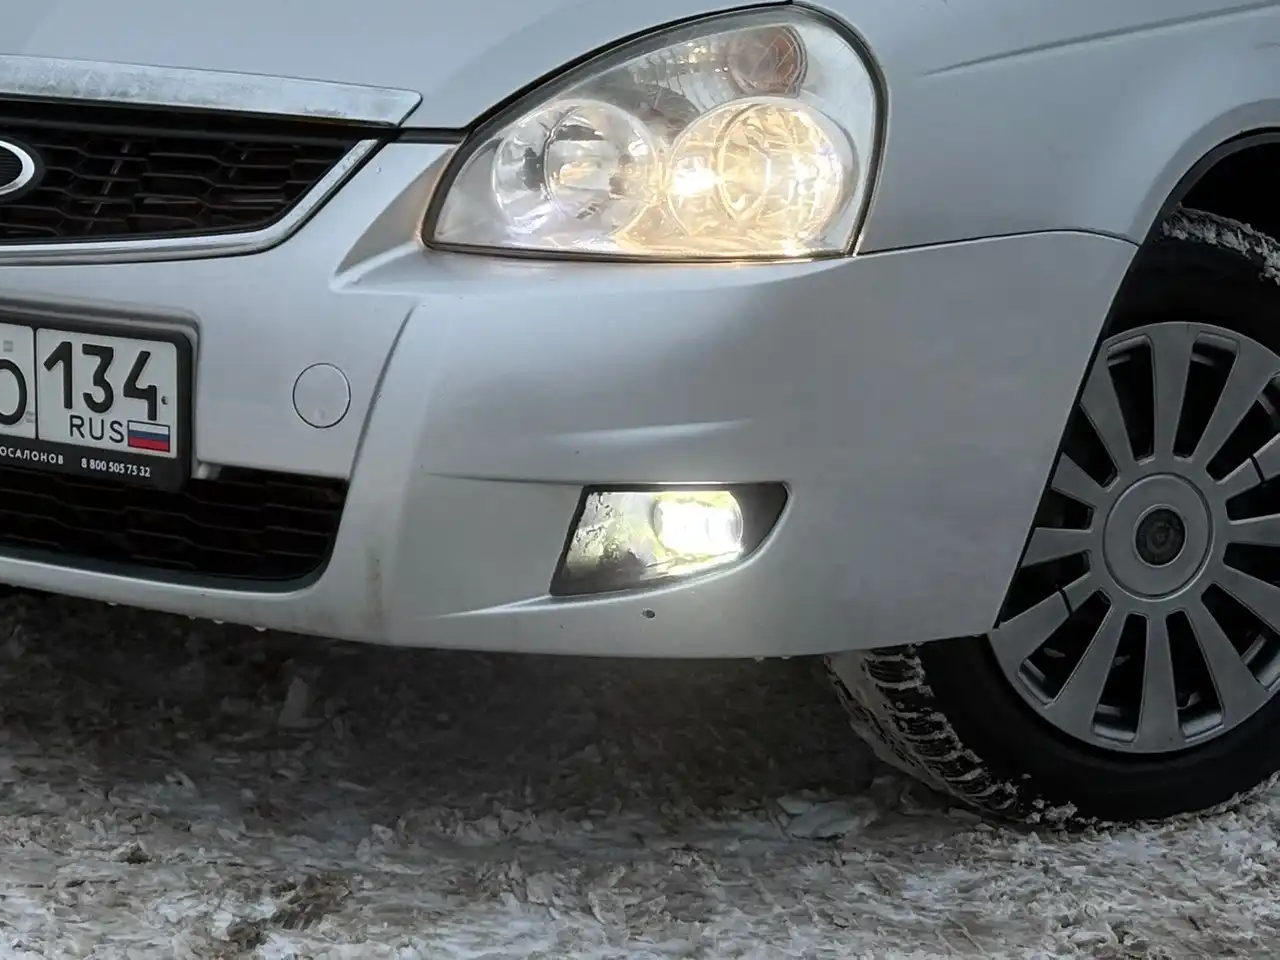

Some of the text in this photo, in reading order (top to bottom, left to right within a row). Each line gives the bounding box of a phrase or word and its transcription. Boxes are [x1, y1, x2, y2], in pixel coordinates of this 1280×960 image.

[43, 341, 157, 421] 134
[69, 414, 125, 443] RUS
[81, 458, 151, 477] 8 800 505 75 32
